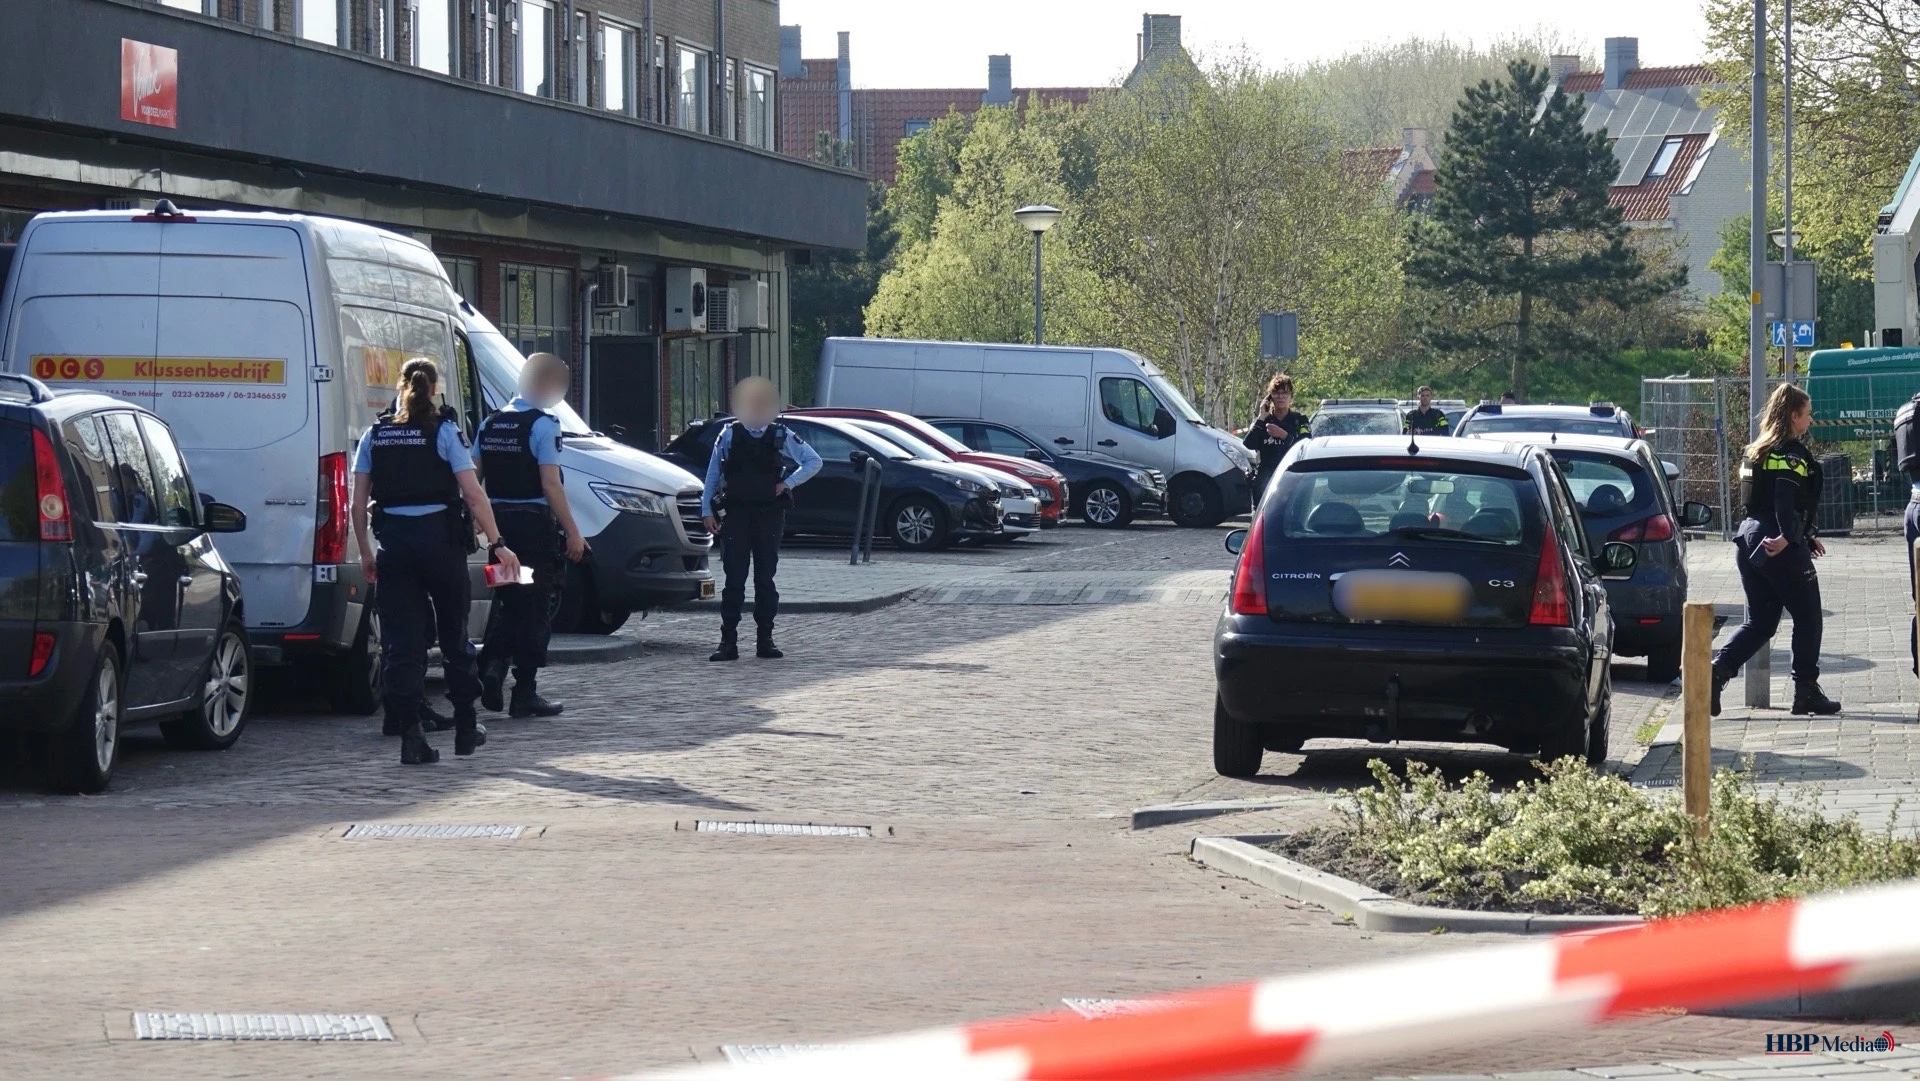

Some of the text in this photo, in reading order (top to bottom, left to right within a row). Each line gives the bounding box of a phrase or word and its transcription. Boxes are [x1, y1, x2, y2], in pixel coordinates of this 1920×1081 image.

[135, 361, 270, 383] Klussenbedrijf
[138, 390, 163, 398] Helder
[233, 392, 287, 400] 06-23466559
[378, 429, 422, 438] KONINKLIJKE
[371, 438, 427, 447] MARECHAUSSEE
[484, 437, 518, 445] KONINKLIJKE
[1271, 572, 1321, 580] CITROËN
